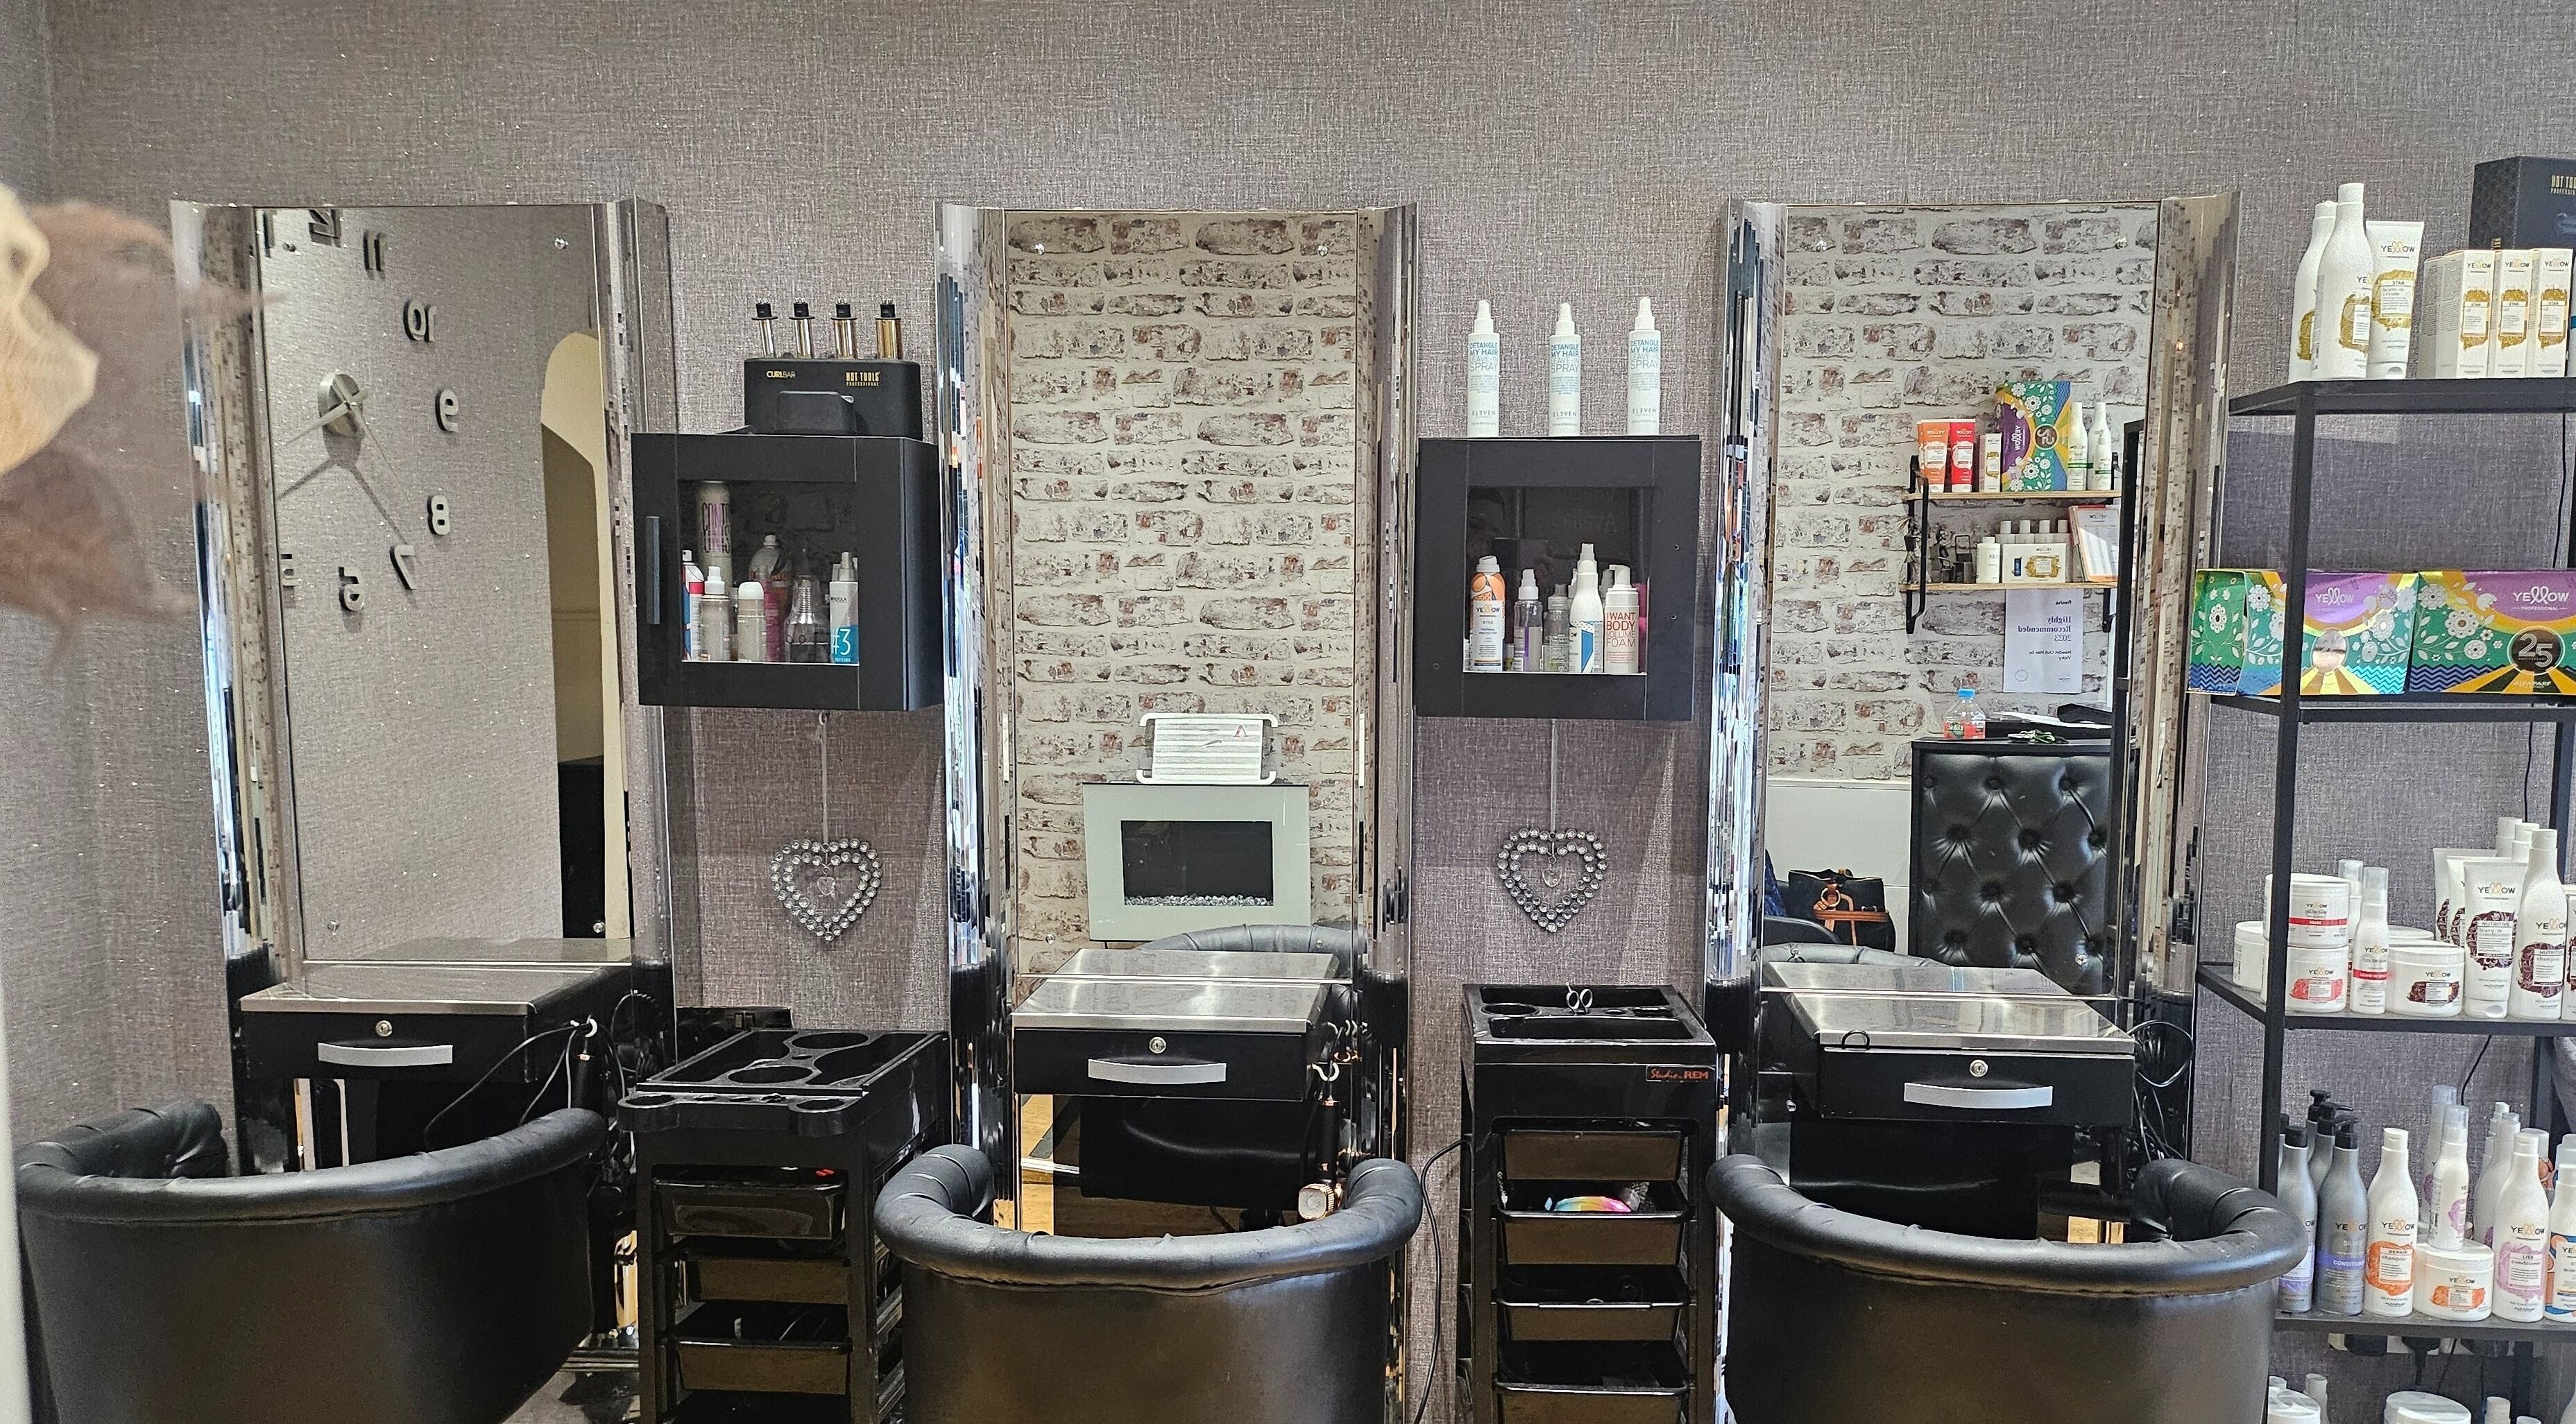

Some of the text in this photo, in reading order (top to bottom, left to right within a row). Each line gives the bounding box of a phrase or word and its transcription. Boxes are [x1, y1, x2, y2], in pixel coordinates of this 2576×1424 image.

[1469, 362, 1498, 372] SPRAY
[1551, 364, 1578, 373] SPRAY
[1630, 361, 1658, 370] SPRAY
[766, 370, 796, 379] CURLBAR
[846, 372, 880, 381] HOT TOOLS
[2315, 587, 2354, 606] YELLOW
[2512, 585, 2570, 605] YELLOW
[1610, 612, 1635, 621] WANT
[1606, 621, 1635, 630] BODY
[1606, 638, 1636, 647] FOAM
[2518, 633, 2553, 667] 25
[2477, 882, 2516, 895] YELLOW
[1684, 1071, 1709, 1079] REM
